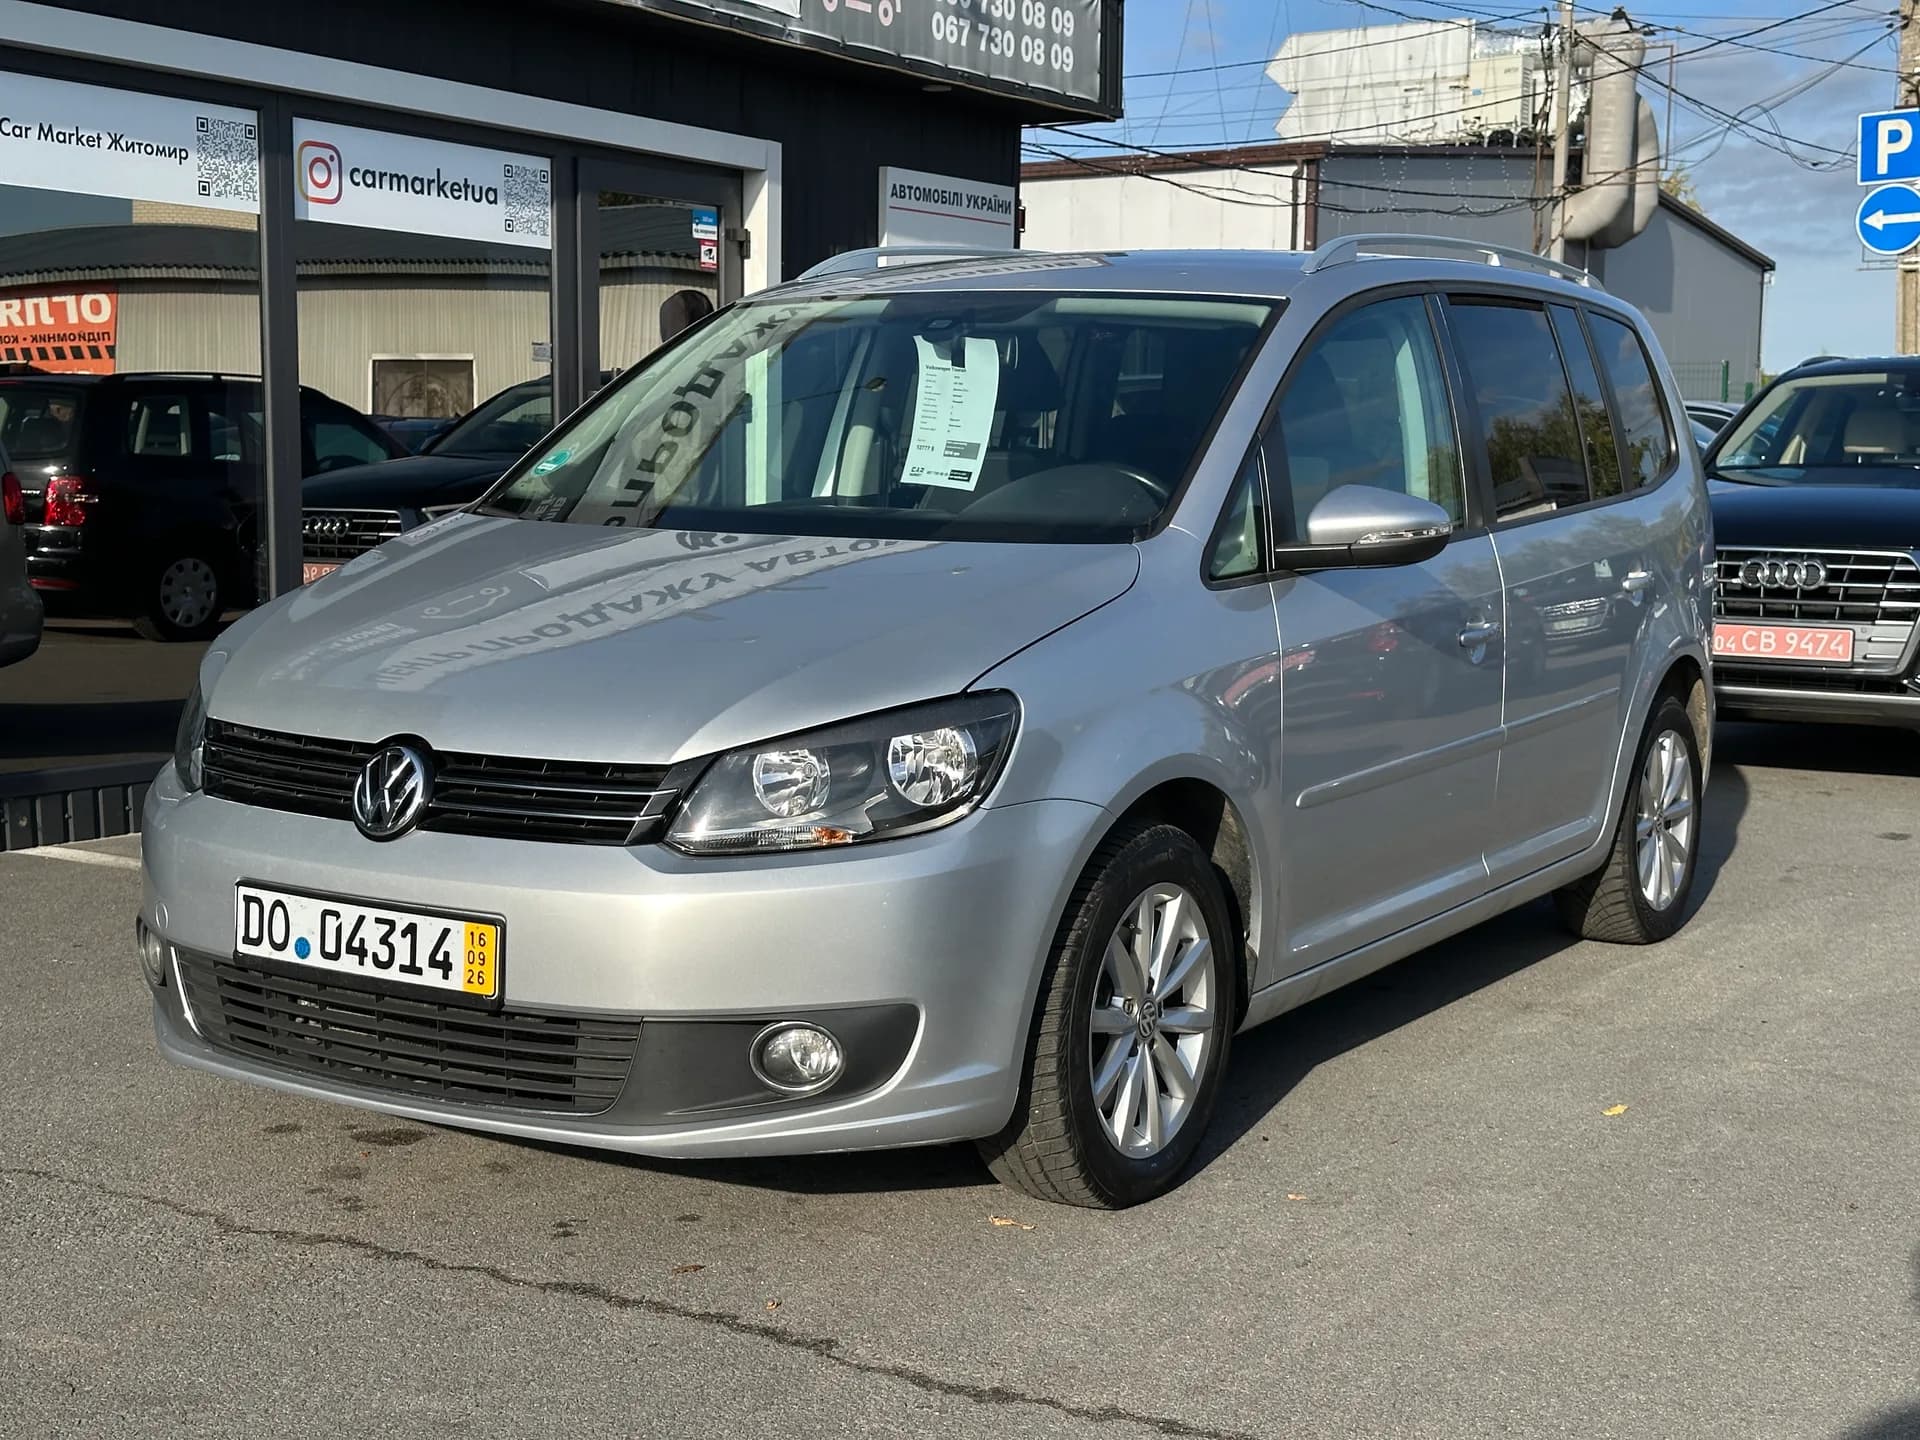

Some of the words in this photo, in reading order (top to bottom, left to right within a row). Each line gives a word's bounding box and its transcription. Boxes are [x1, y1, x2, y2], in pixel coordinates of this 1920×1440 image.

[1021, 0, 1046, 29] 08
[1051, 6, 1075, 37] 09
[931, 11, 971, 47] 067
[978, 22, 1016, 58] 730
[1021, 35, 1046, 66] 08
[1051, 43, 1075, 73] 09
[0, 117, 32, 139] Car
[38, 122, 103, 149] Market
[107, 131, 189, 165] Житомир
[1877, 119, 1913, 175] P
[349, 162, 499, 206] carmarketua
[890, 183, 963, 207] АВТОМОБІЛІ
[966, 193, 1012, 215] УКРАЇНИ
[1714, 635, 1736, 652] 04
[1785, 631, 1846, 656] 9474
[242, 894, 291, 952] DO
[320, 908, 453, 981] 04314
[469, 930, 487, 948] 16
[466, 969, 486, 986] 26
[467, 951, 487, 967] 09
